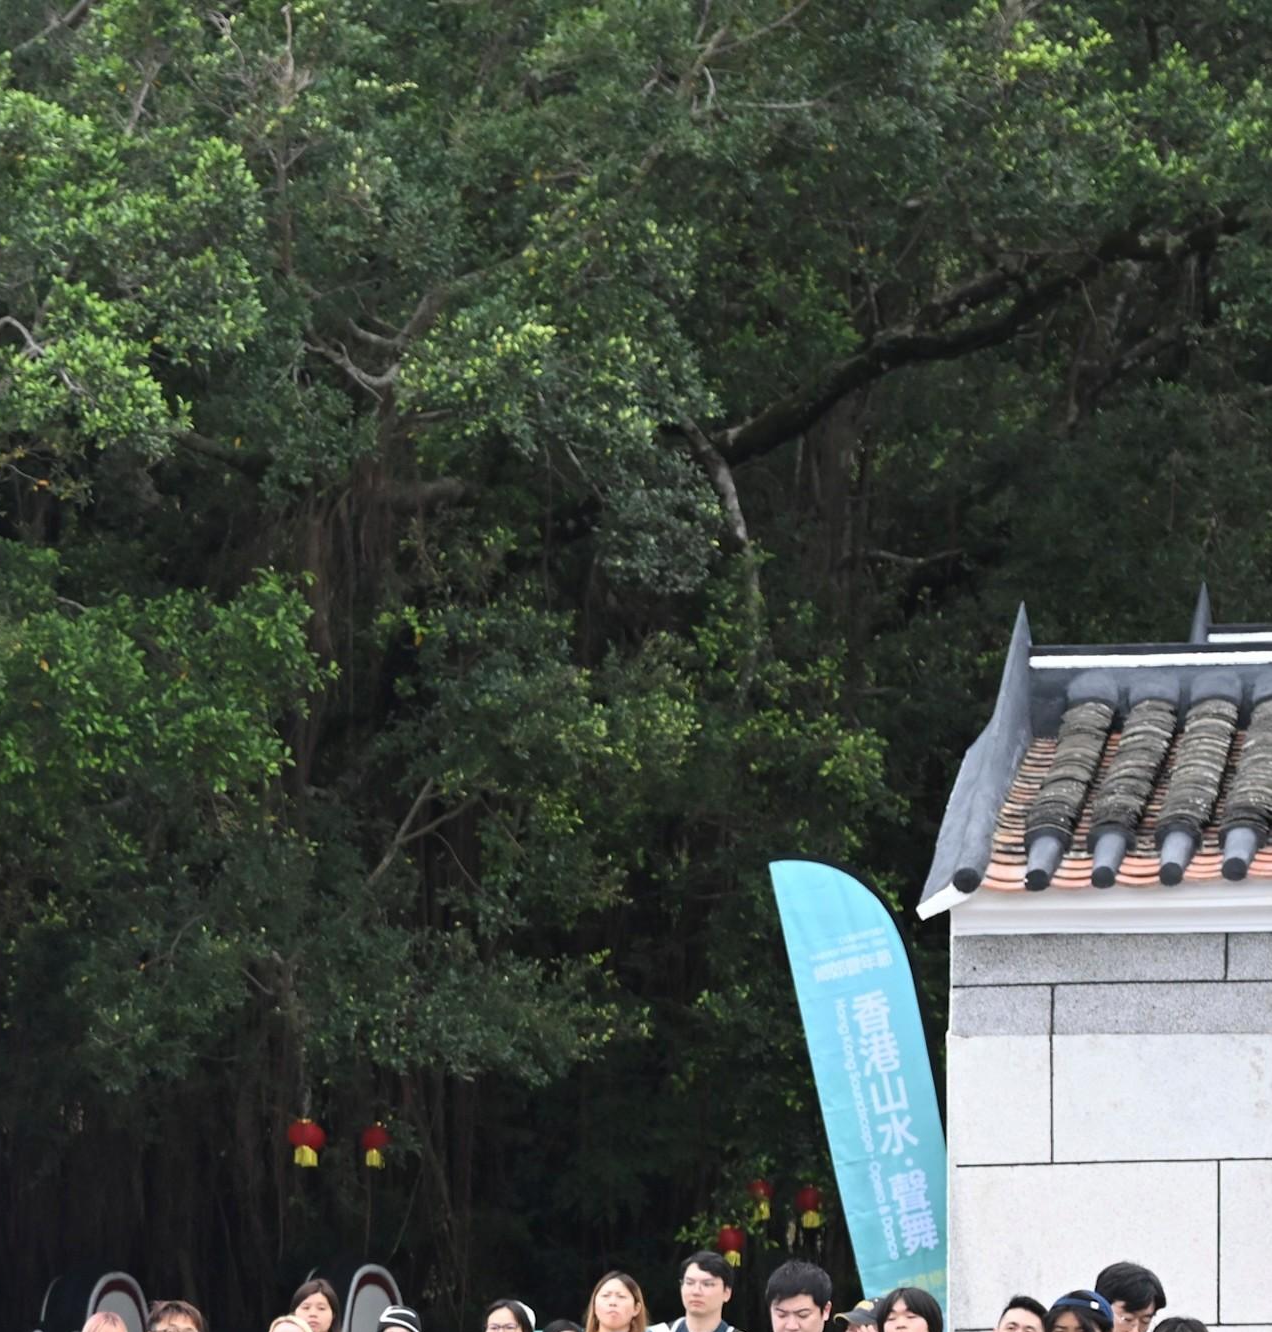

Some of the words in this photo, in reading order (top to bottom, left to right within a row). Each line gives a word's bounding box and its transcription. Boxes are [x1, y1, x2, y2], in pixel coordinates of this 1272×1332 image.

[835, 997, 850, 1034] Hong
[842, 1035, 857, 1070] Kong
[881, 1216, 899, 1260] Dance
